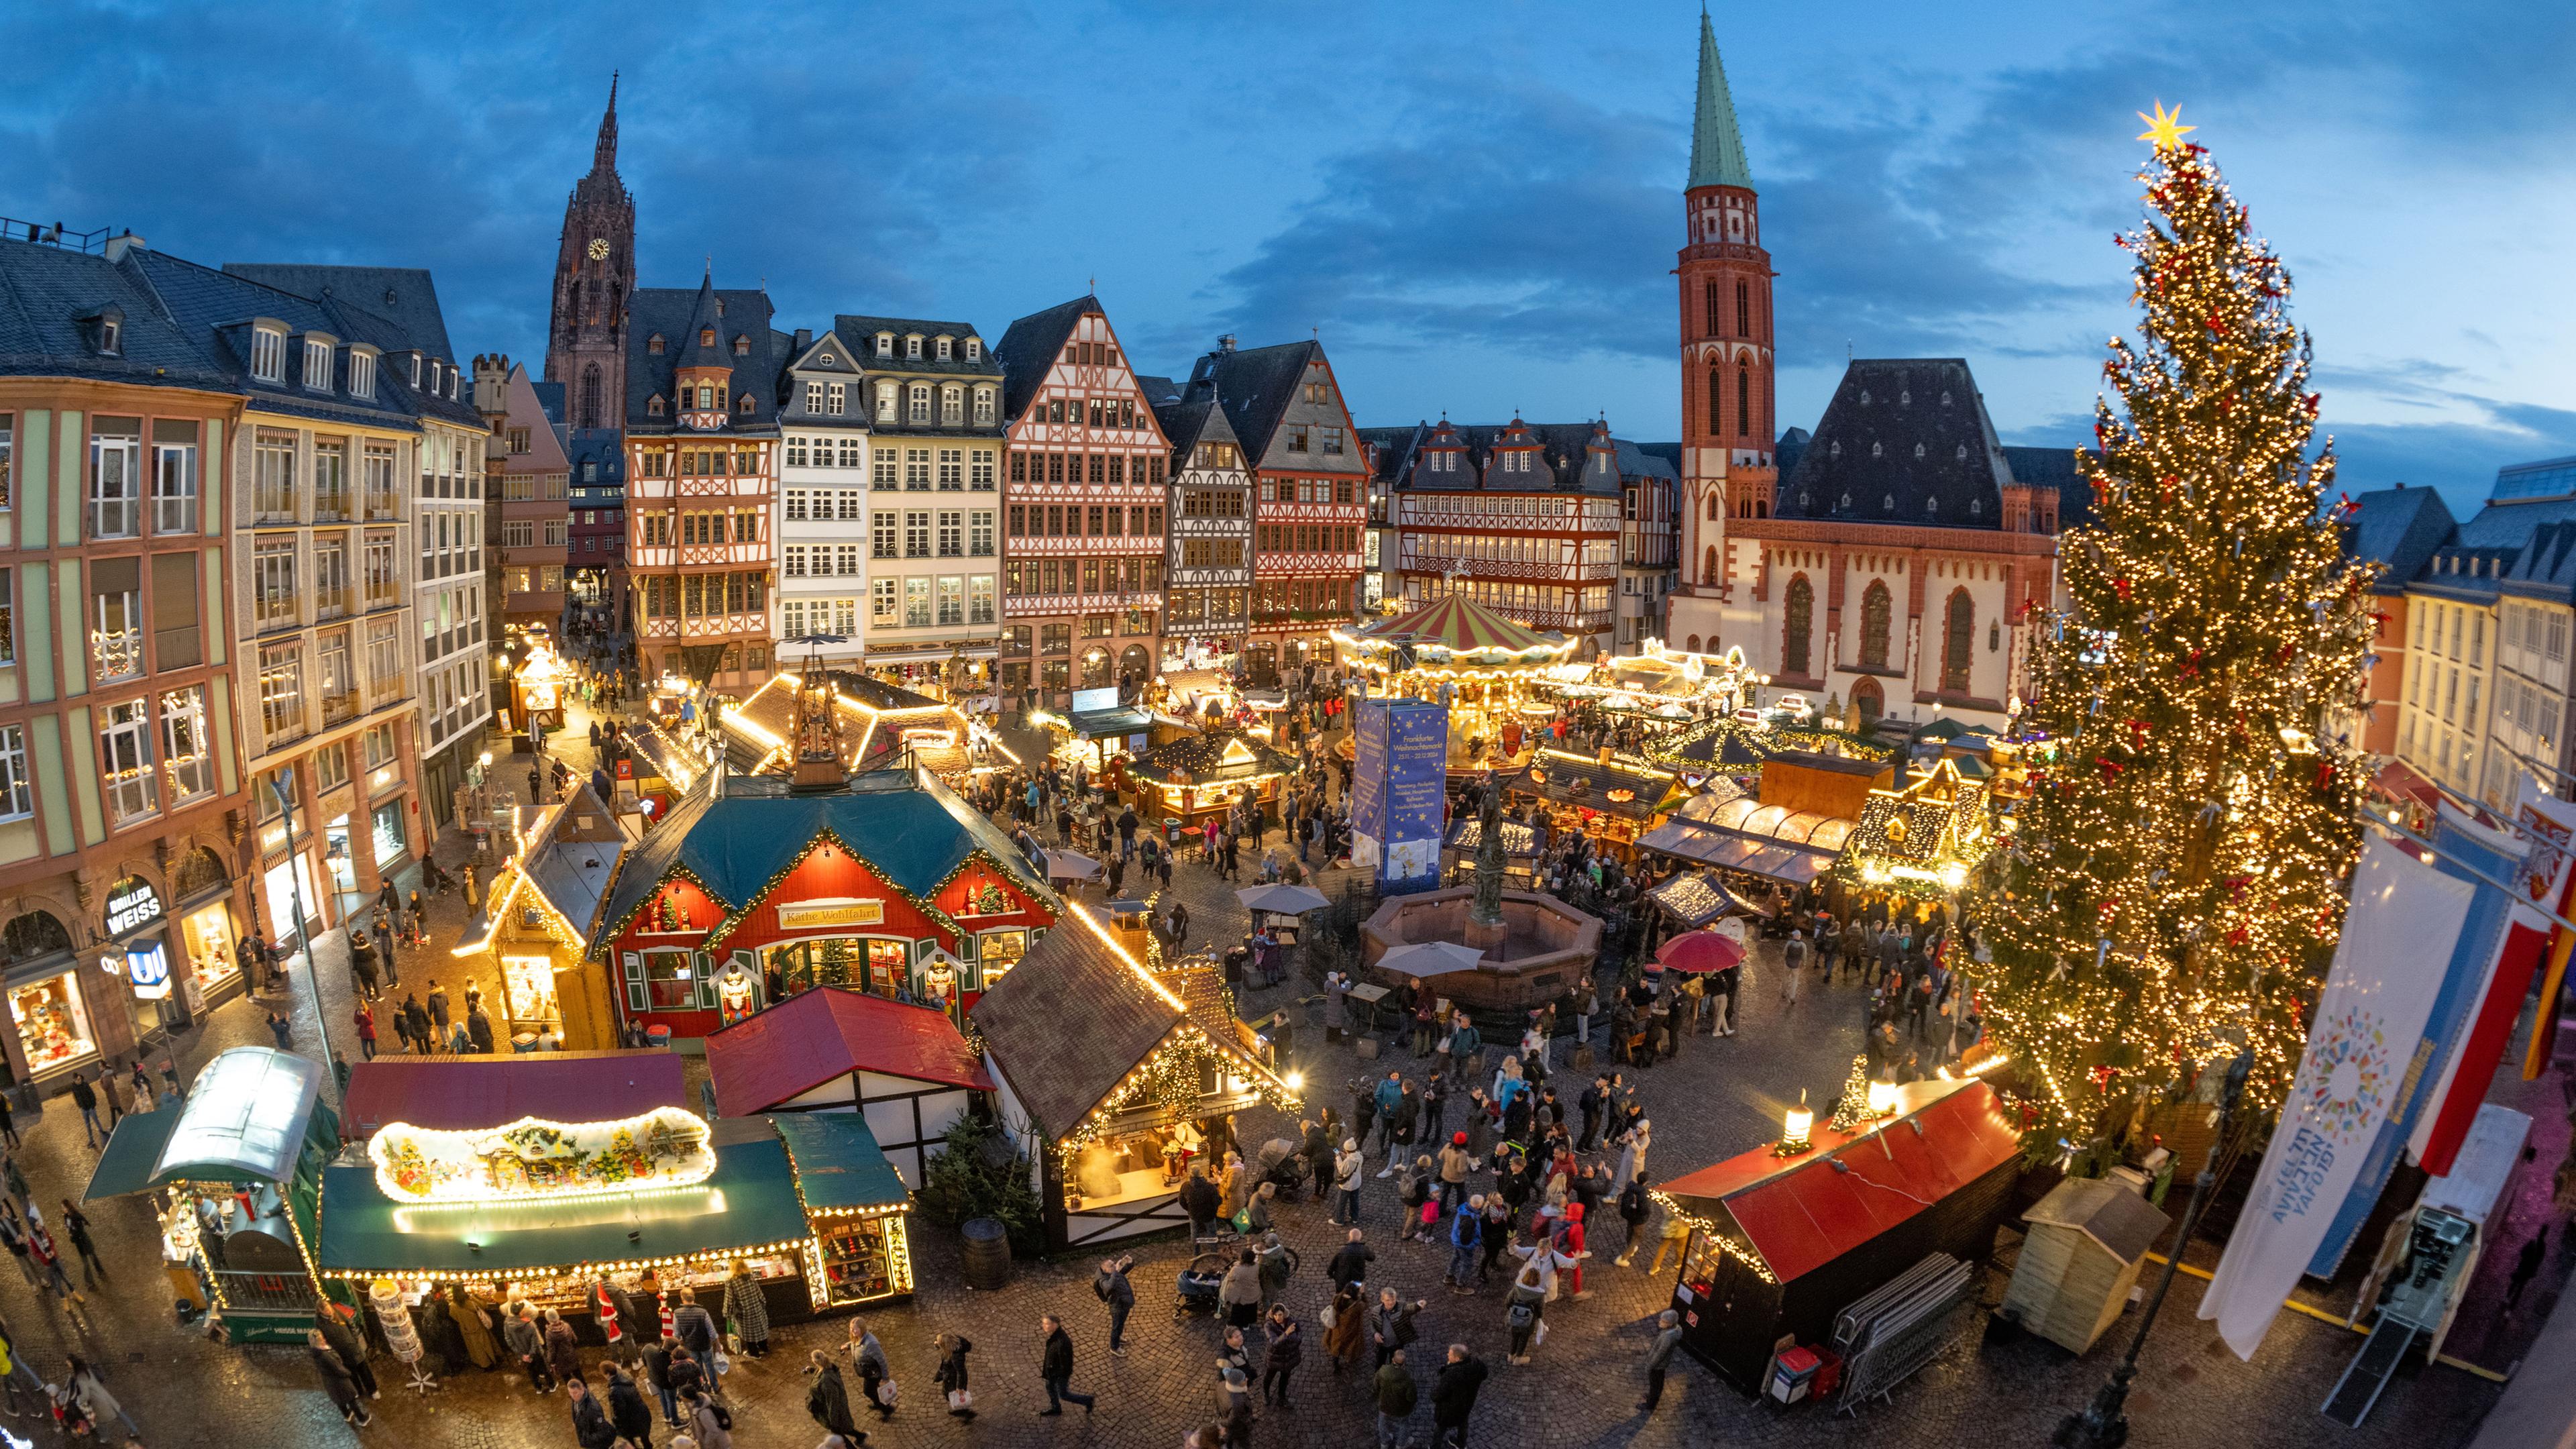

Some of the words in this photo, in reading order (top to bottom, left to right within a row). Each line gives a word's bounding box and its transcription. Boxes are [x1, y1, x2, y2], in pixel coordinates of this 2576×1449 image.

[869, 643, 914, 653] Souvenirs
[944, 639, 991, 649] Geschenke
[1393, 741, 1442, 751] Weihnachtsmarkt
[1403, 734, 1434, 743] Frankfurter
[109, 885, 152, 914] BRILLEN
[107, 898, 160, 934] WEISS
[787, 912, 818, 922] Käthe
[822, 908, 876, 920] Wohlfahrt
[128, 953, 156, 983] U
[2271, 1180, 2301, 1224] AVIV
[2292, 1171, 2324, 1216] YAFO
